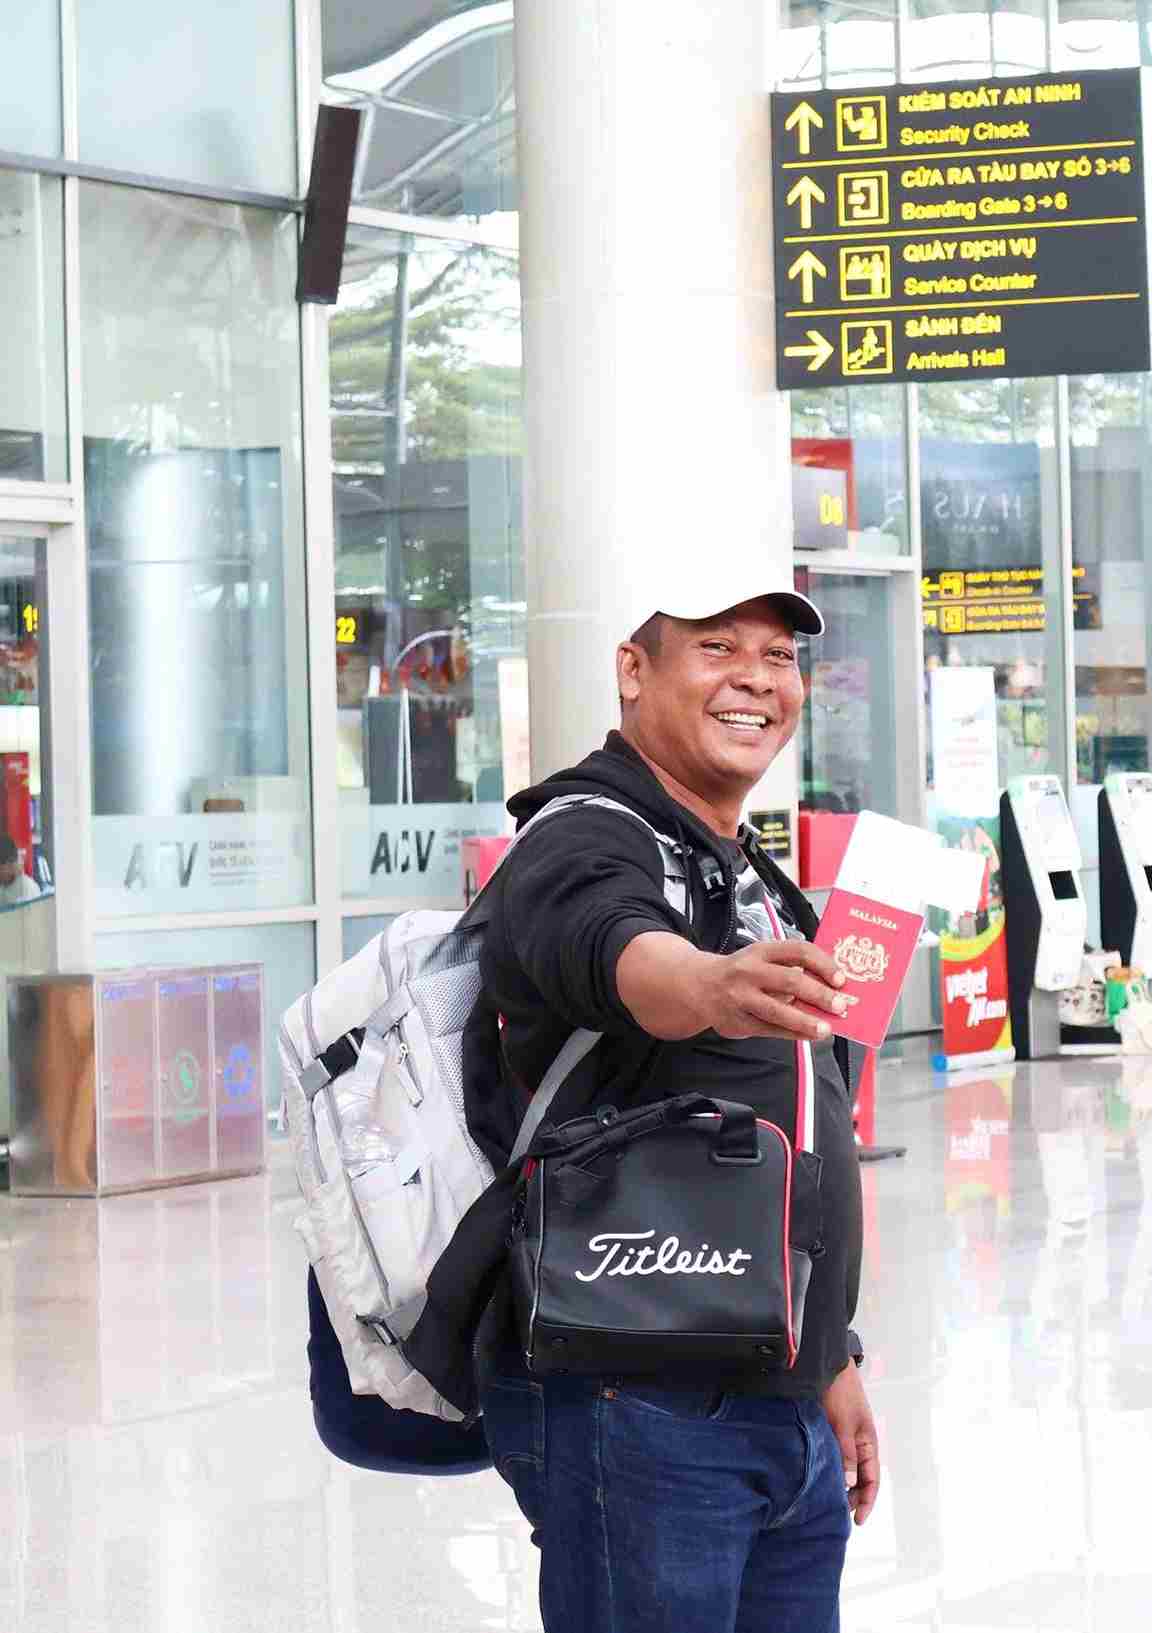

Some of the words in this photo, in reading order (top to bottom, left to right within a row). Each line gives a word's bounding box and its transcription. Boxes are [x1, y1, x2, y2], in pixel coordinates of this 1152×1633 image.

[1004, 87, 1032, 105] AN
[1035, 83, 1082, 103] NINH
[900, 125, 970, 145] Security
[973, 120, 1030, 140] Check
[947, 166, 976, 185] RA
[1020, 161, 1061, 180] BAY
[902, 200, 976, 221] Boarding
[978, 197, 1021, 216] Gate
[903, 276, 967, 296] Service
[969, 272, 1037, 292] Counter
[906, 350, 969, 370] Arrivals
[972, 348, 1006, 368] Hall
[336, 616, 358, 645] 22
[849, 906, 897, 930] MALAYSIA
[575, 1229, 752, 1282] Titleist
